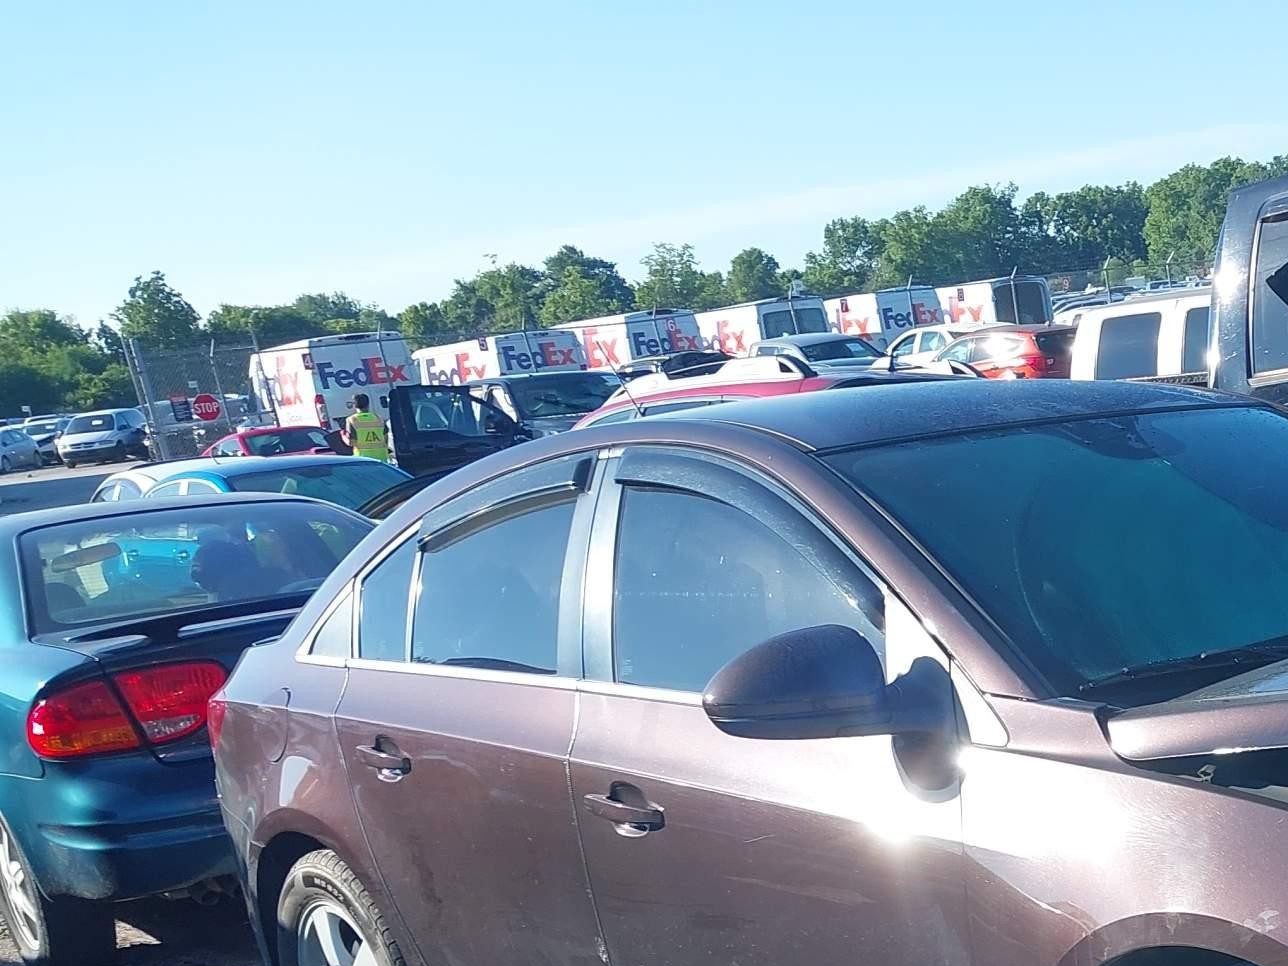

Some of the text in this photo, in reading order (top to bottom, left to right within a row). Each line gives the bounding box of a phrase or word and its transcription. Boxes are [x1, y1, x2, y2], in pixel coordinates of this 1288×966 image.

[667, 318, 676, 332] 6
[882, 302, 938, 330] FedEx
[479, 338, 487, 350] 5
[632, 330, 698, 357] FedEx
[304, 355, 313, 369] 4
[502, 342, 576, 370] FedEx
[315, 357, 411, 389] FedEx
[194, 402, 219, 414] STOP
